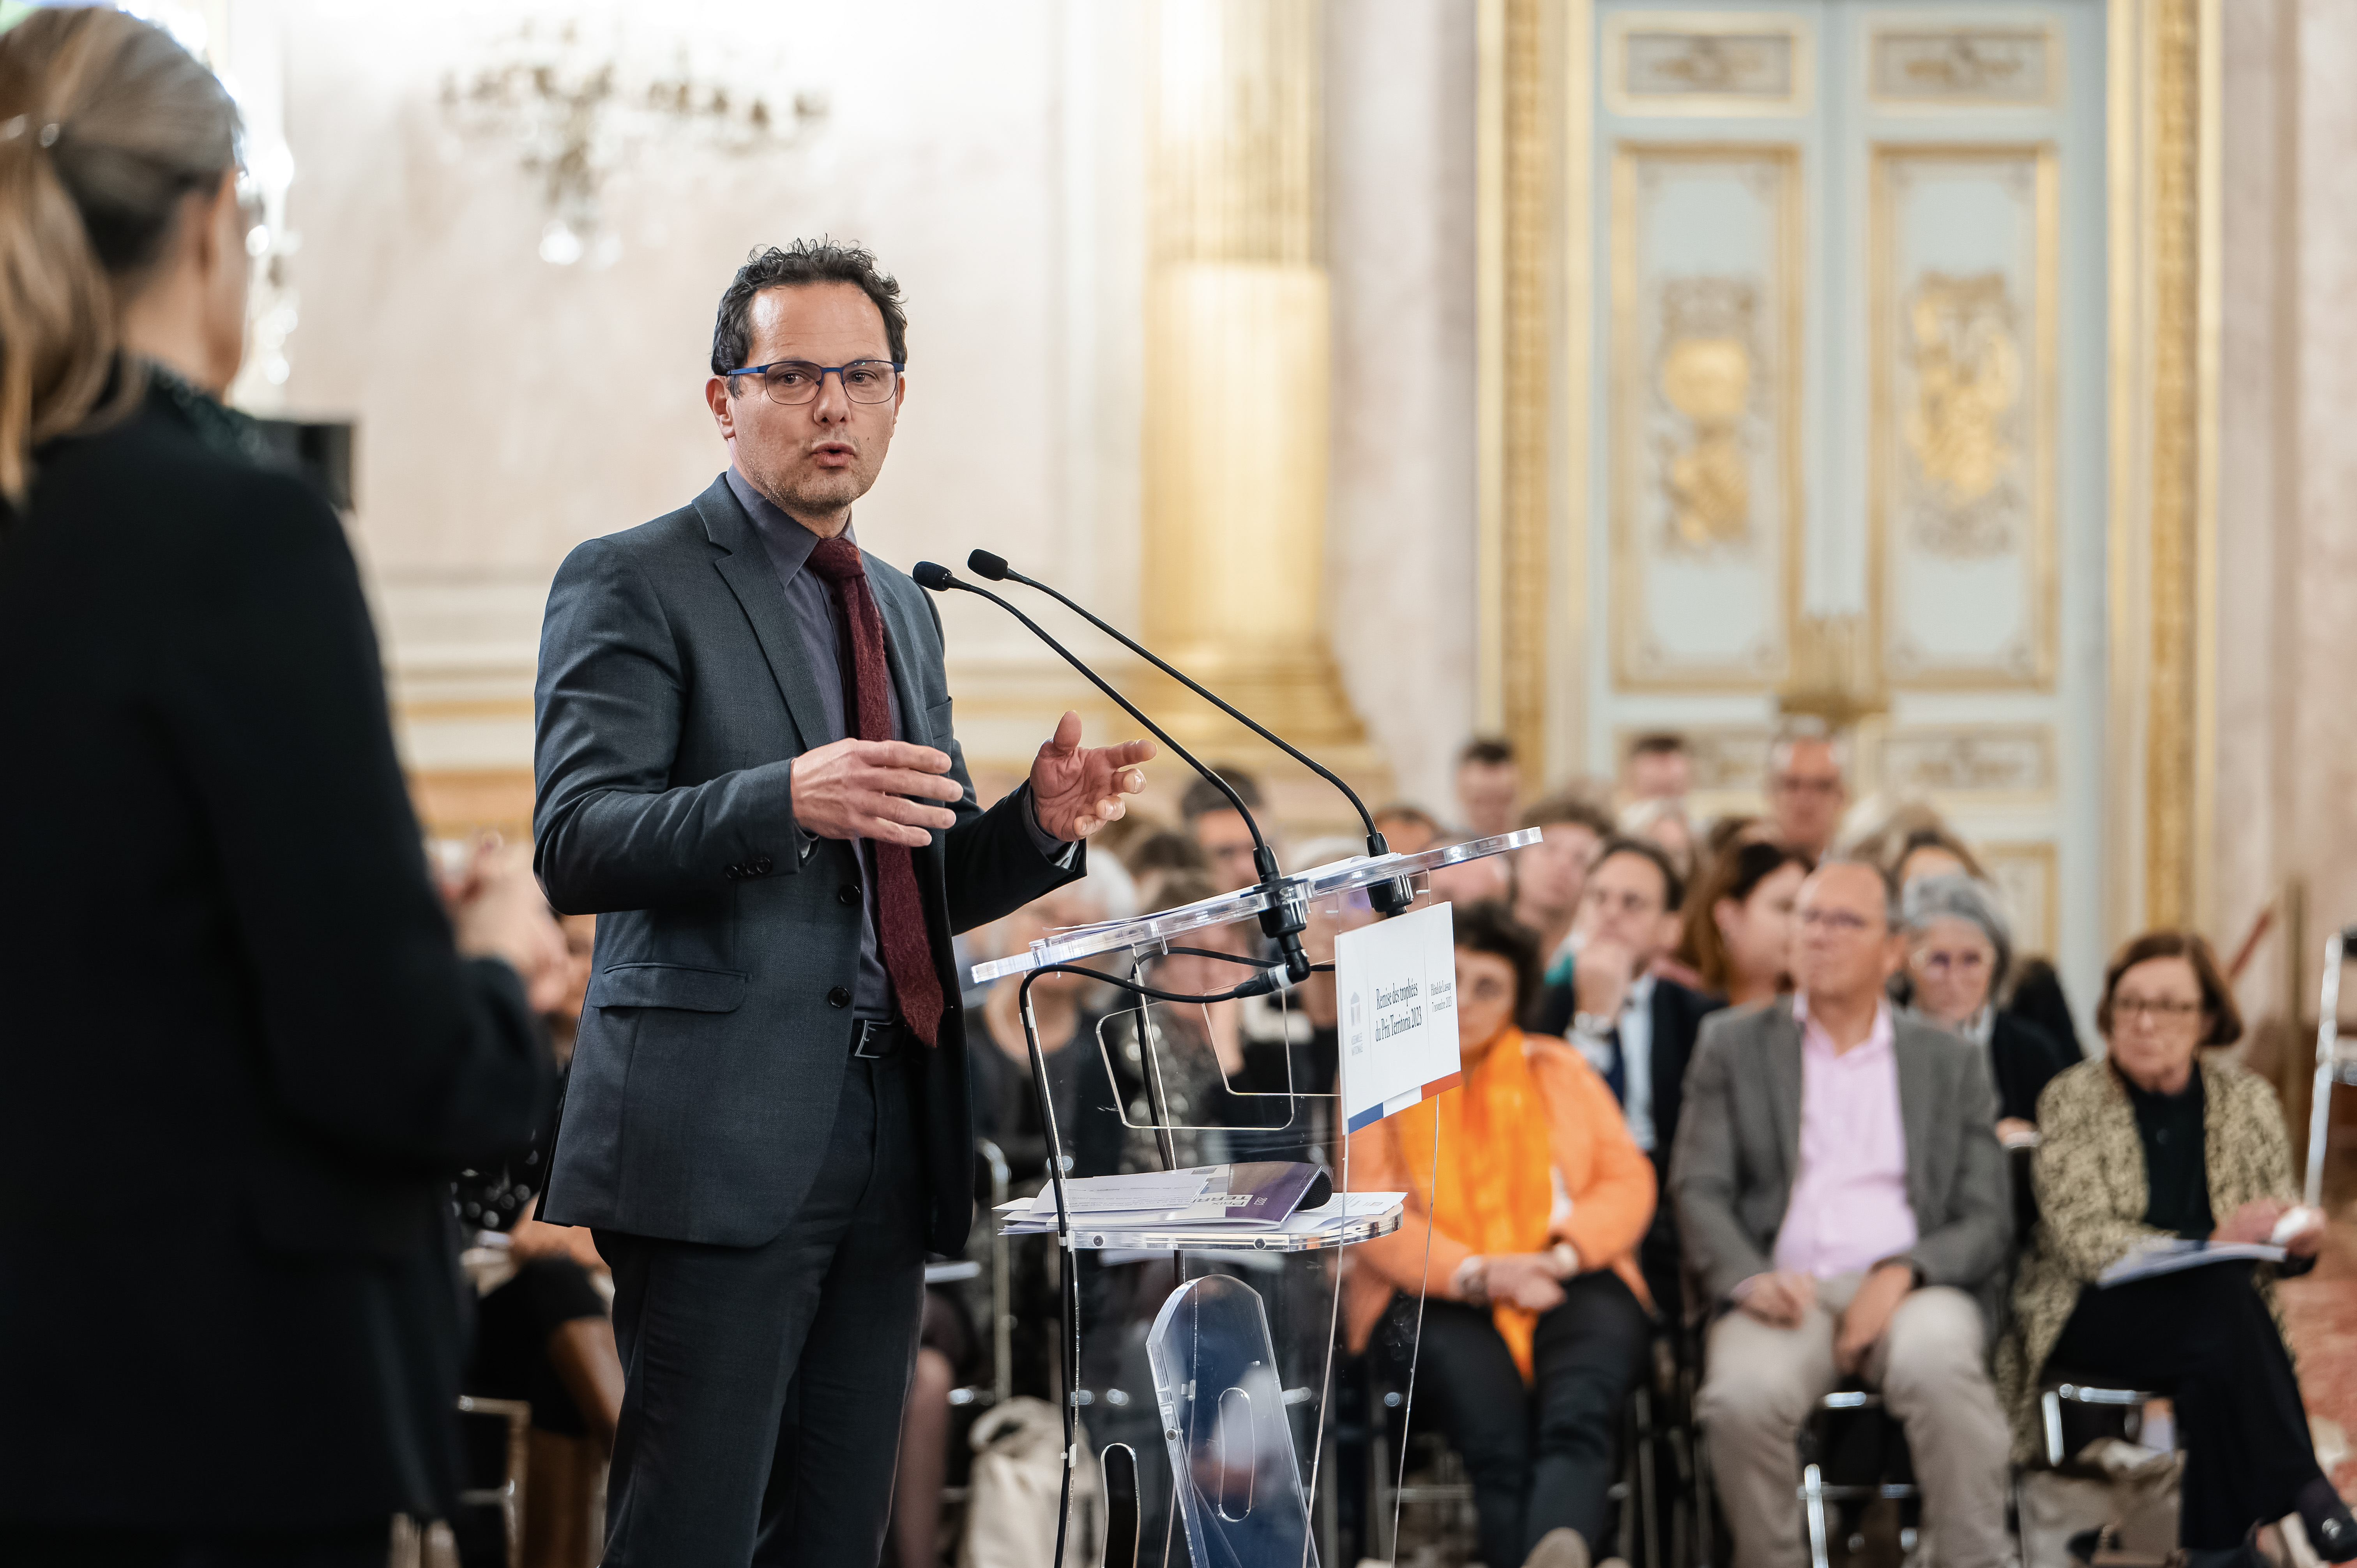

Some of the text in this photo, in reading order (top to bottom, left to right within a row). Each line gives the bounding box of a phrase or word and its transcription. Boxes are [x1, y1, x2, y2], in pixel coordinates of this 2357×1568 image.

[1376, 987, 1391, 1010] Remise
[1400, 977, 1418, 1006] trophées
[1431, 980, 1451, 996] Hôtel de Lassay
[1432, 1002, 1434, 1012] 7
[1434, 998, 1445, 1012] novembre
[1375, 1021, 1381, 1042] du
[1381, 1018, 1390, 1040] Prix
[1390, 1011, 1411, 1036] Territoria
[1411, 1005, 1422, 1028] 2023
